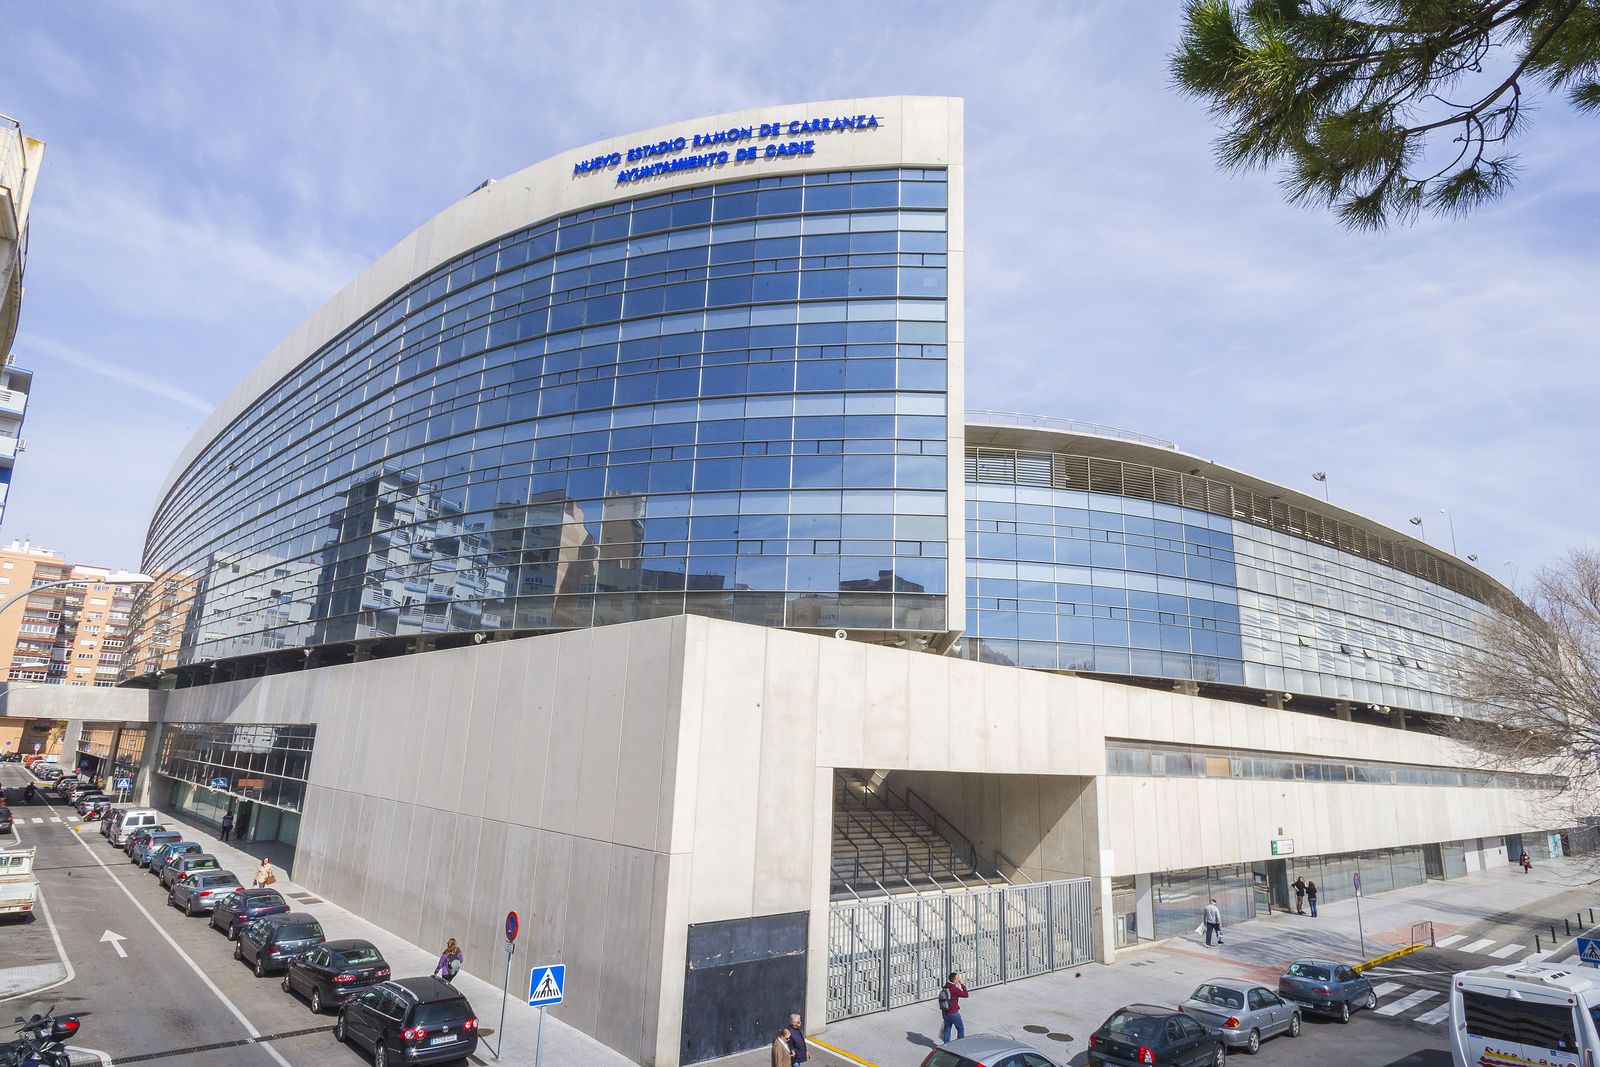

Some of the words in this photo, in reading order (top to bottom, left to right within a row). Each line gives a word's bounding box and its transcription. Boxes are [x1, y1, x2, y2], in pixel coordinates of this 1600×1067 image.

[574, 152, 622, 174] NUEVO
[627, 136, 686, 162] ESTADIO
[693, 125, 753, 147] RAMON
[760, 122, 781, 137] DE
[789, 114, 879, 134] CARRANZA
[616, 149, 729, 184] AYUNTAMIENTO
[736, 146, 758, 161] DE
[765, 140, 816, 157] CADIZ
